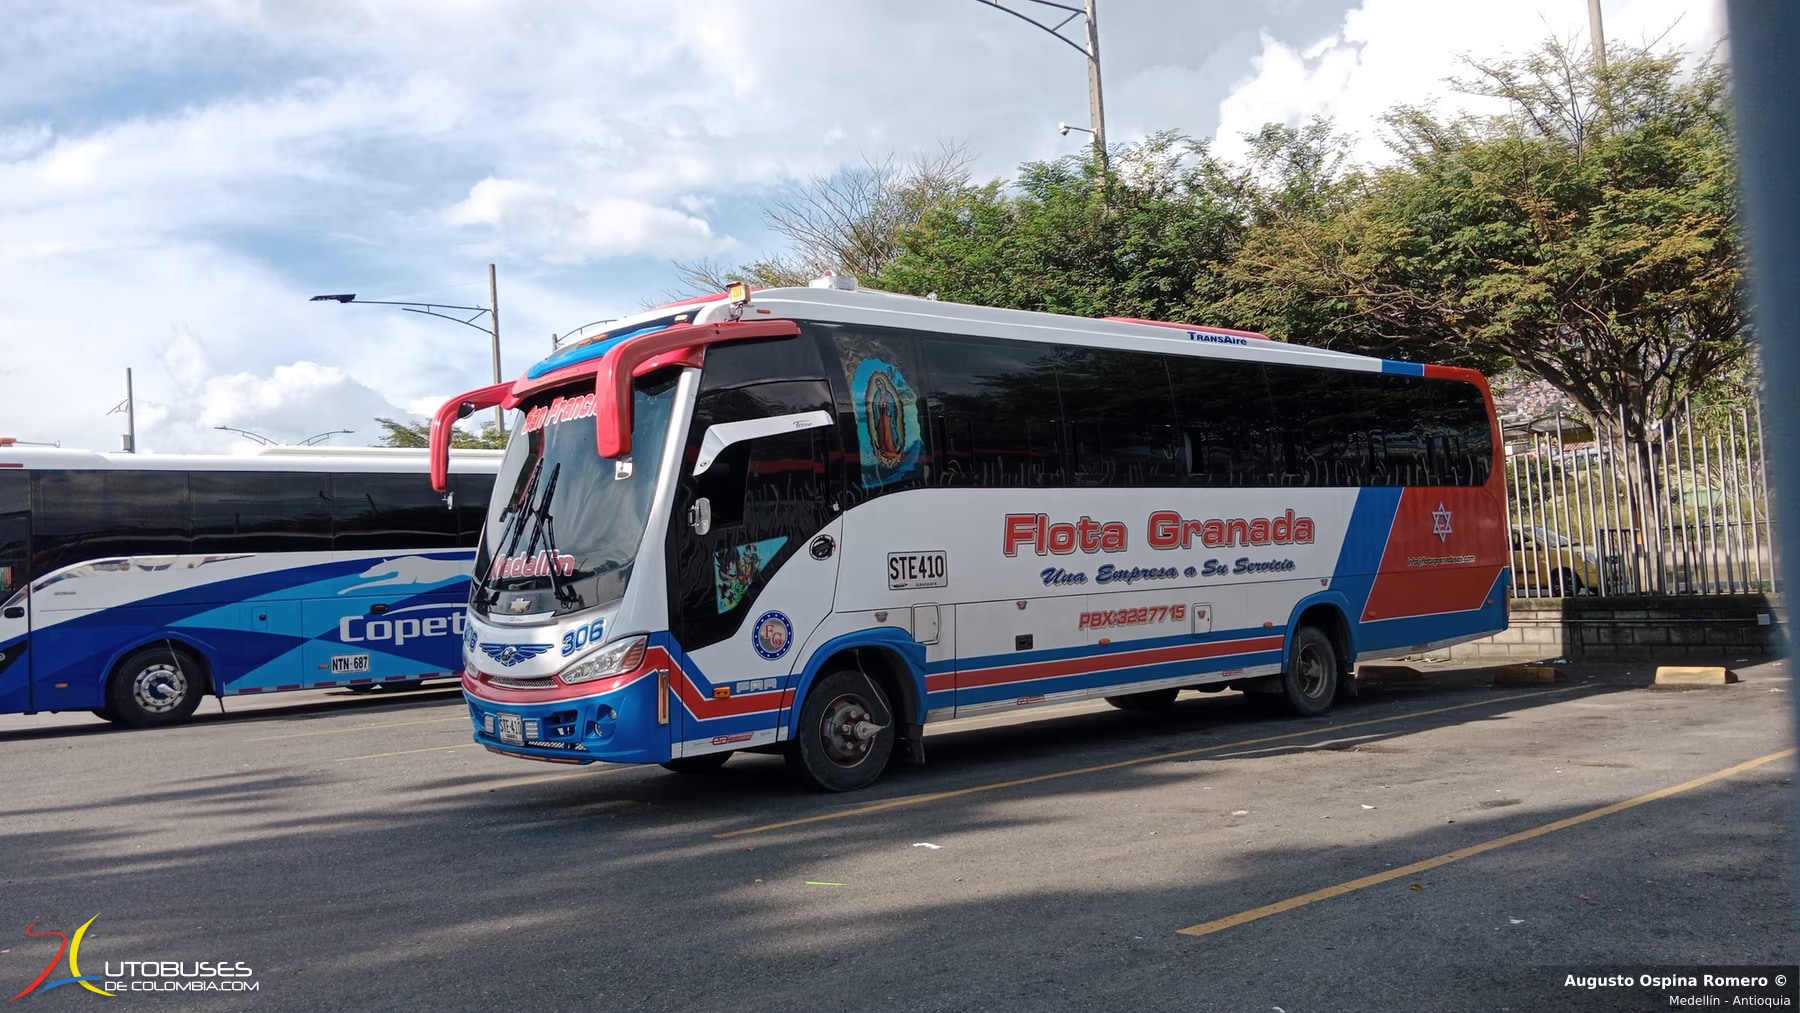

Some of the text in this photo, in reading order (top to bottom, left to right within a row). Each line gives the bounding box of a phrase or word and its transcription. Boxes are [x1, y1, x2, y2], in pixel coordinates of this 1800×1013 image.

[1002, 508, 1316, 557] Flota Granada
[889, 554, 944, 580] STE410
[1041, 556, 1296, 587] Una Empresa a Su Servicio
[1078, 603, 1187, 631] PBX:3227715
[561, 617, 606, 657] 306
